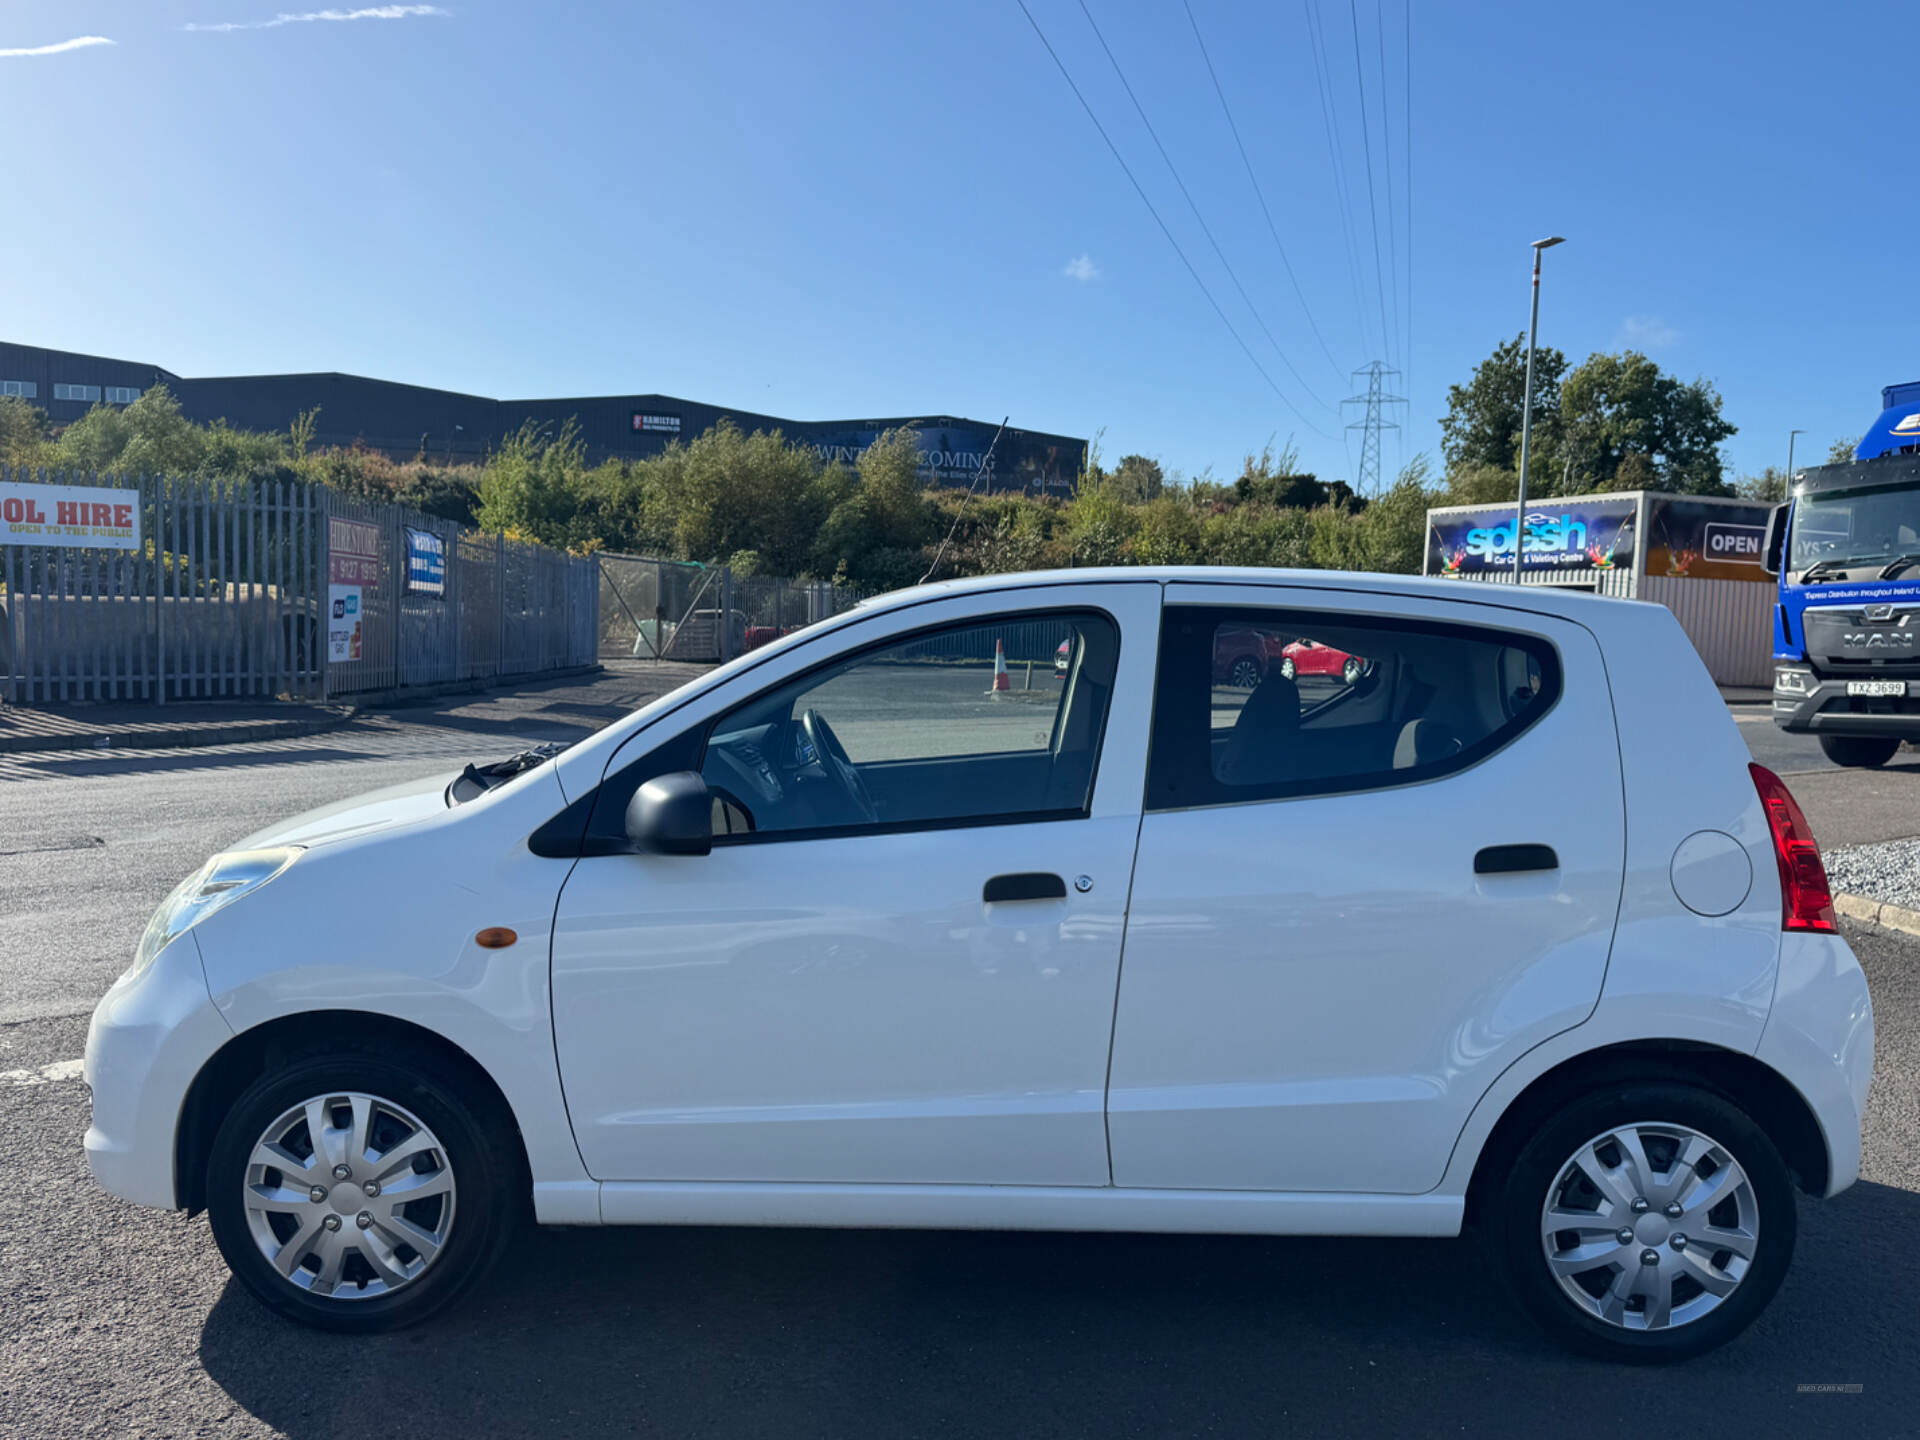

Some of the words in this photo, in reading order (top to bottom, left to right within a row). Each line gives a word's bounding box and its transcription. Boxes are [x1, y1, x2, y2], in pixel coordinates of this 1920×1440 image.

[642, 415, 680, 425] HAMILTON
[0, 498, 45, 524] OL
[57, 501, 133, 528] HIRE
[9, 524, 42, 534] OPEN
[45, 526, 61, 535] TO
[64, 527, 88, 537] THE
[92, 528, 133, 538] PUBLIC
[1466, 514, 1586, 563] splash
[1711, 534, 1759, 554] OPEN
[1531, 554, 1559, 565] Valeting
[1560, 552, 1584, 563] Centre
[1844, 632, 1912, 648] MAN
[1874, 683, 1902, 694] 3699
